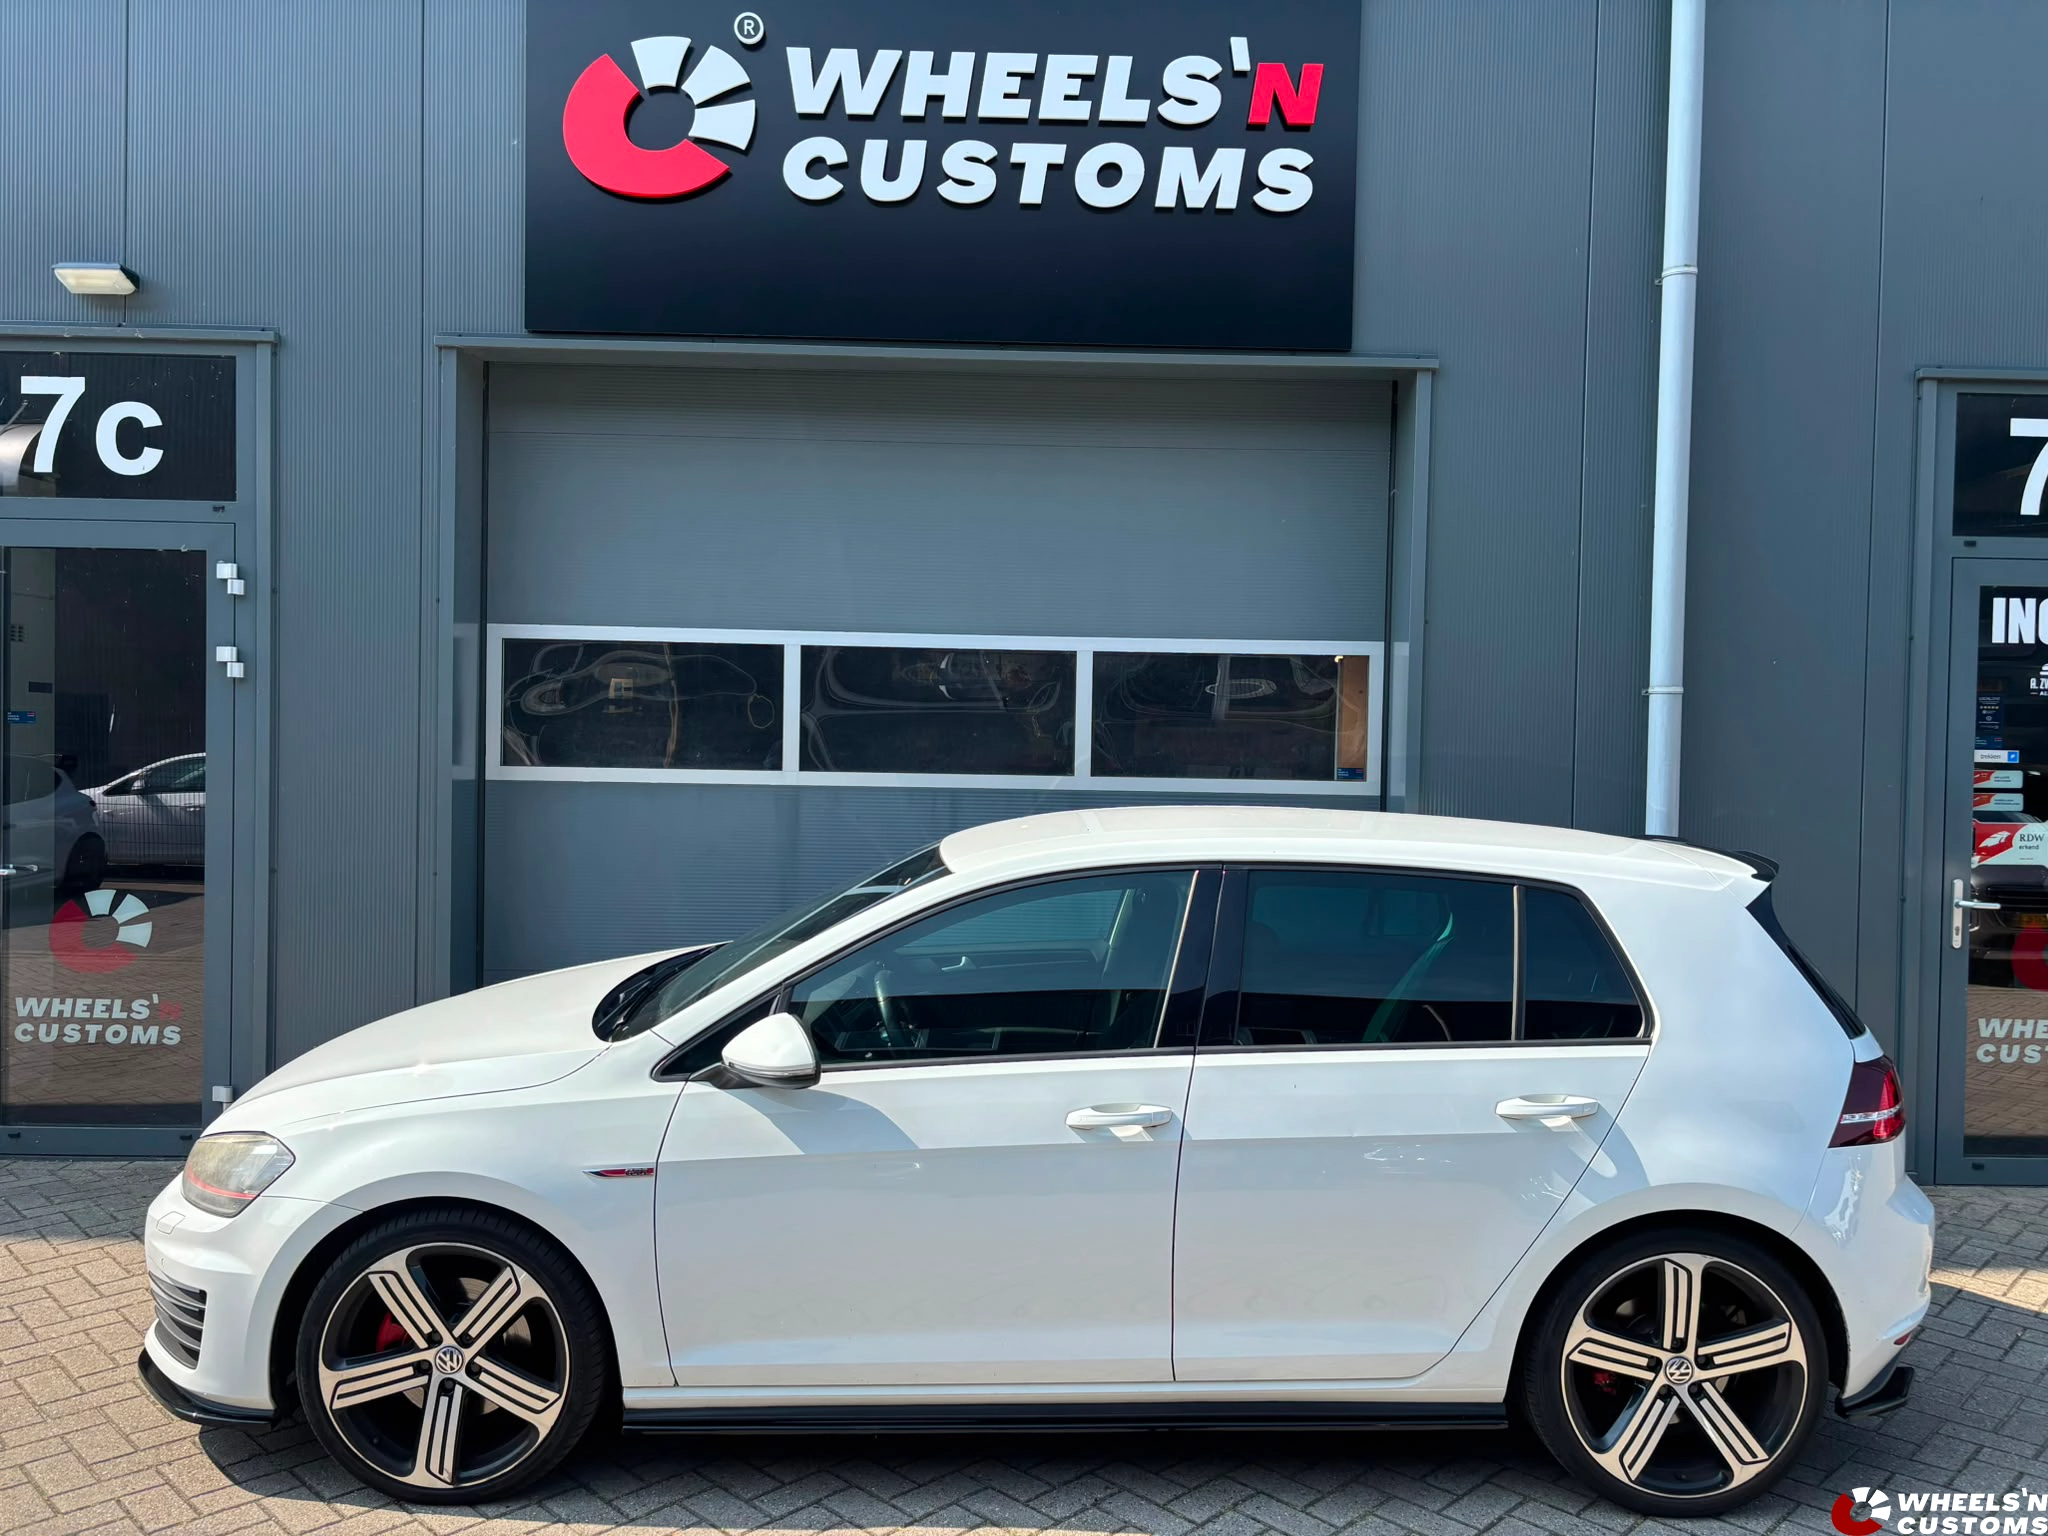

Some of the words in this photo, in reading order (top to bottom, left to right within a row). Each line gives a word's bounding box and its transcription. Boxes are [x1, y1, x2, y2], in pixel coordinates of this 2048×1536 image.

[782, 136, 1314, 213] CUSTOMS
[2009, 417, 2048, 516] 7
[2019, 833, 2045, 842] RDW
[14, 1023, 182, 1045] CUSTOMS
[1976, 1043, 2048, 1064] CUS
